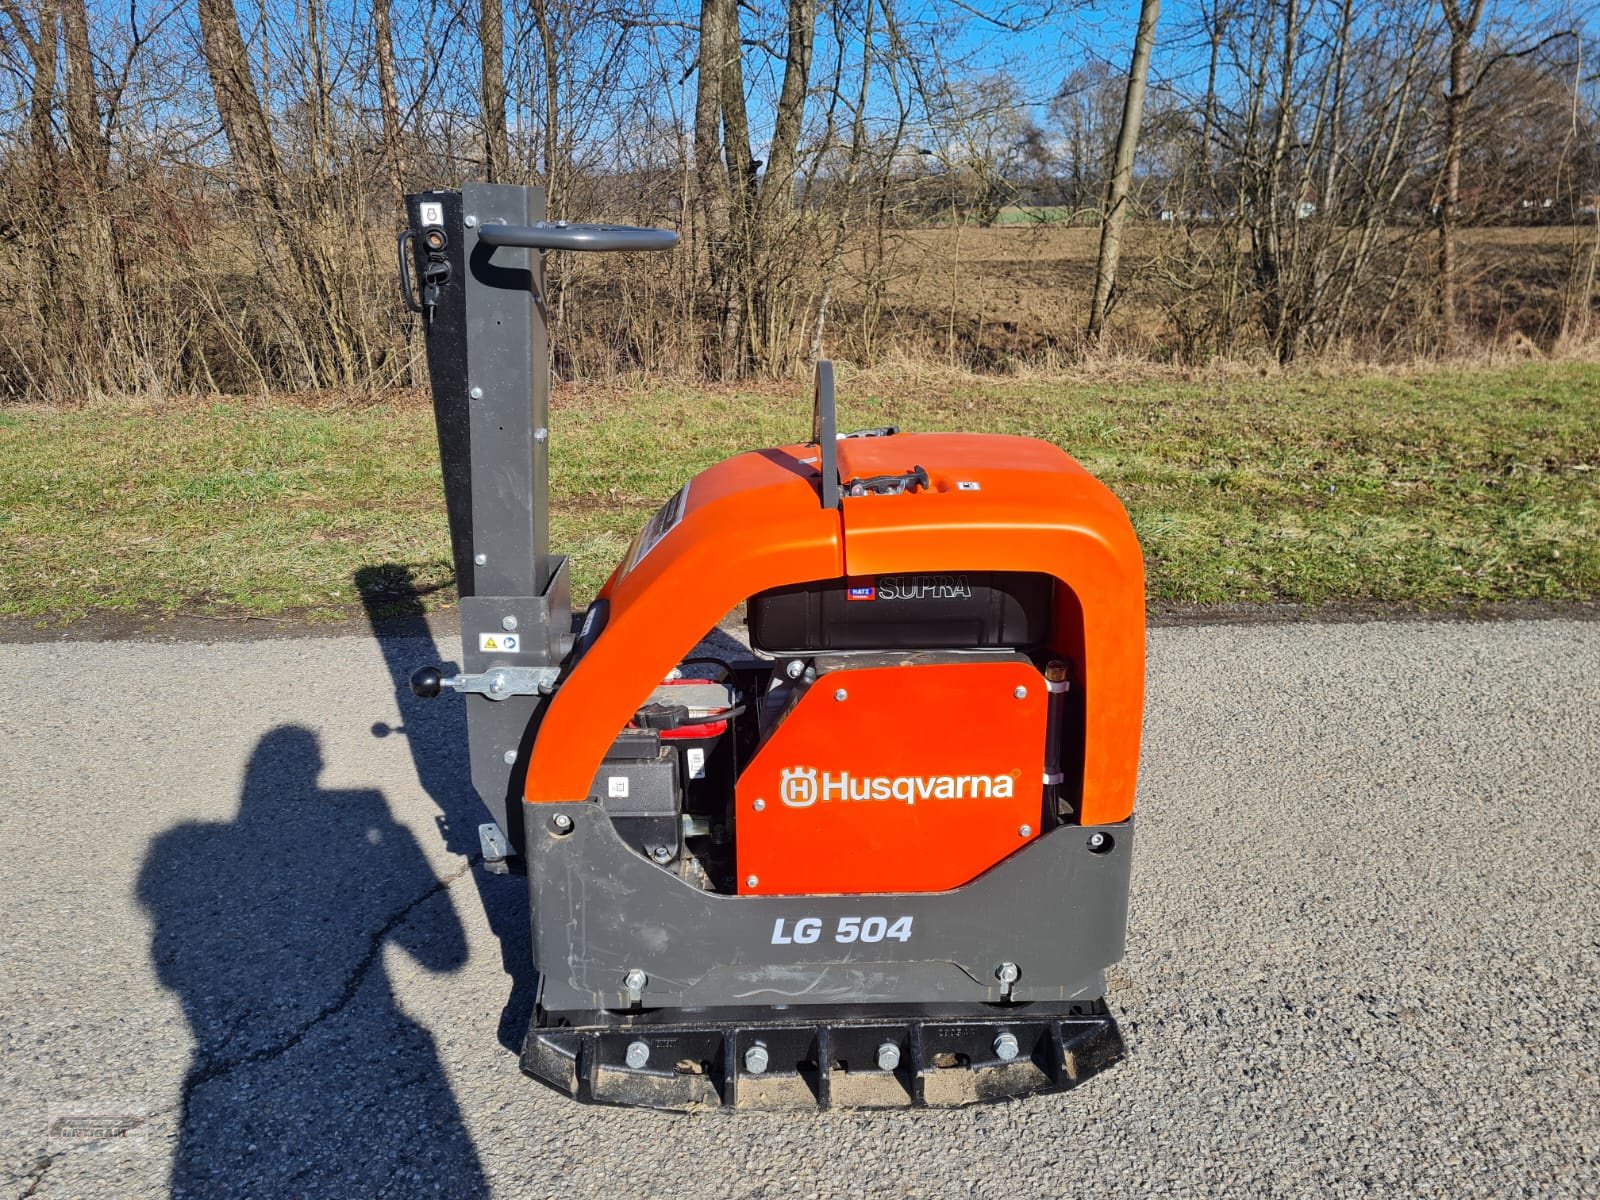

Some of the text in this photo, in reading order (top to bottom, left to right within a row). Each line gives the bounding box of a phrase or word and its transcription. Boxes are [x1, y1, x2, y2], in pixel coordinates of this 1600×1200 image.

[879, 575, 972, 600] SUPRA
[822, 772, 1014, 805] Husqvarna
[771, 916, 914, 945] LG 504
